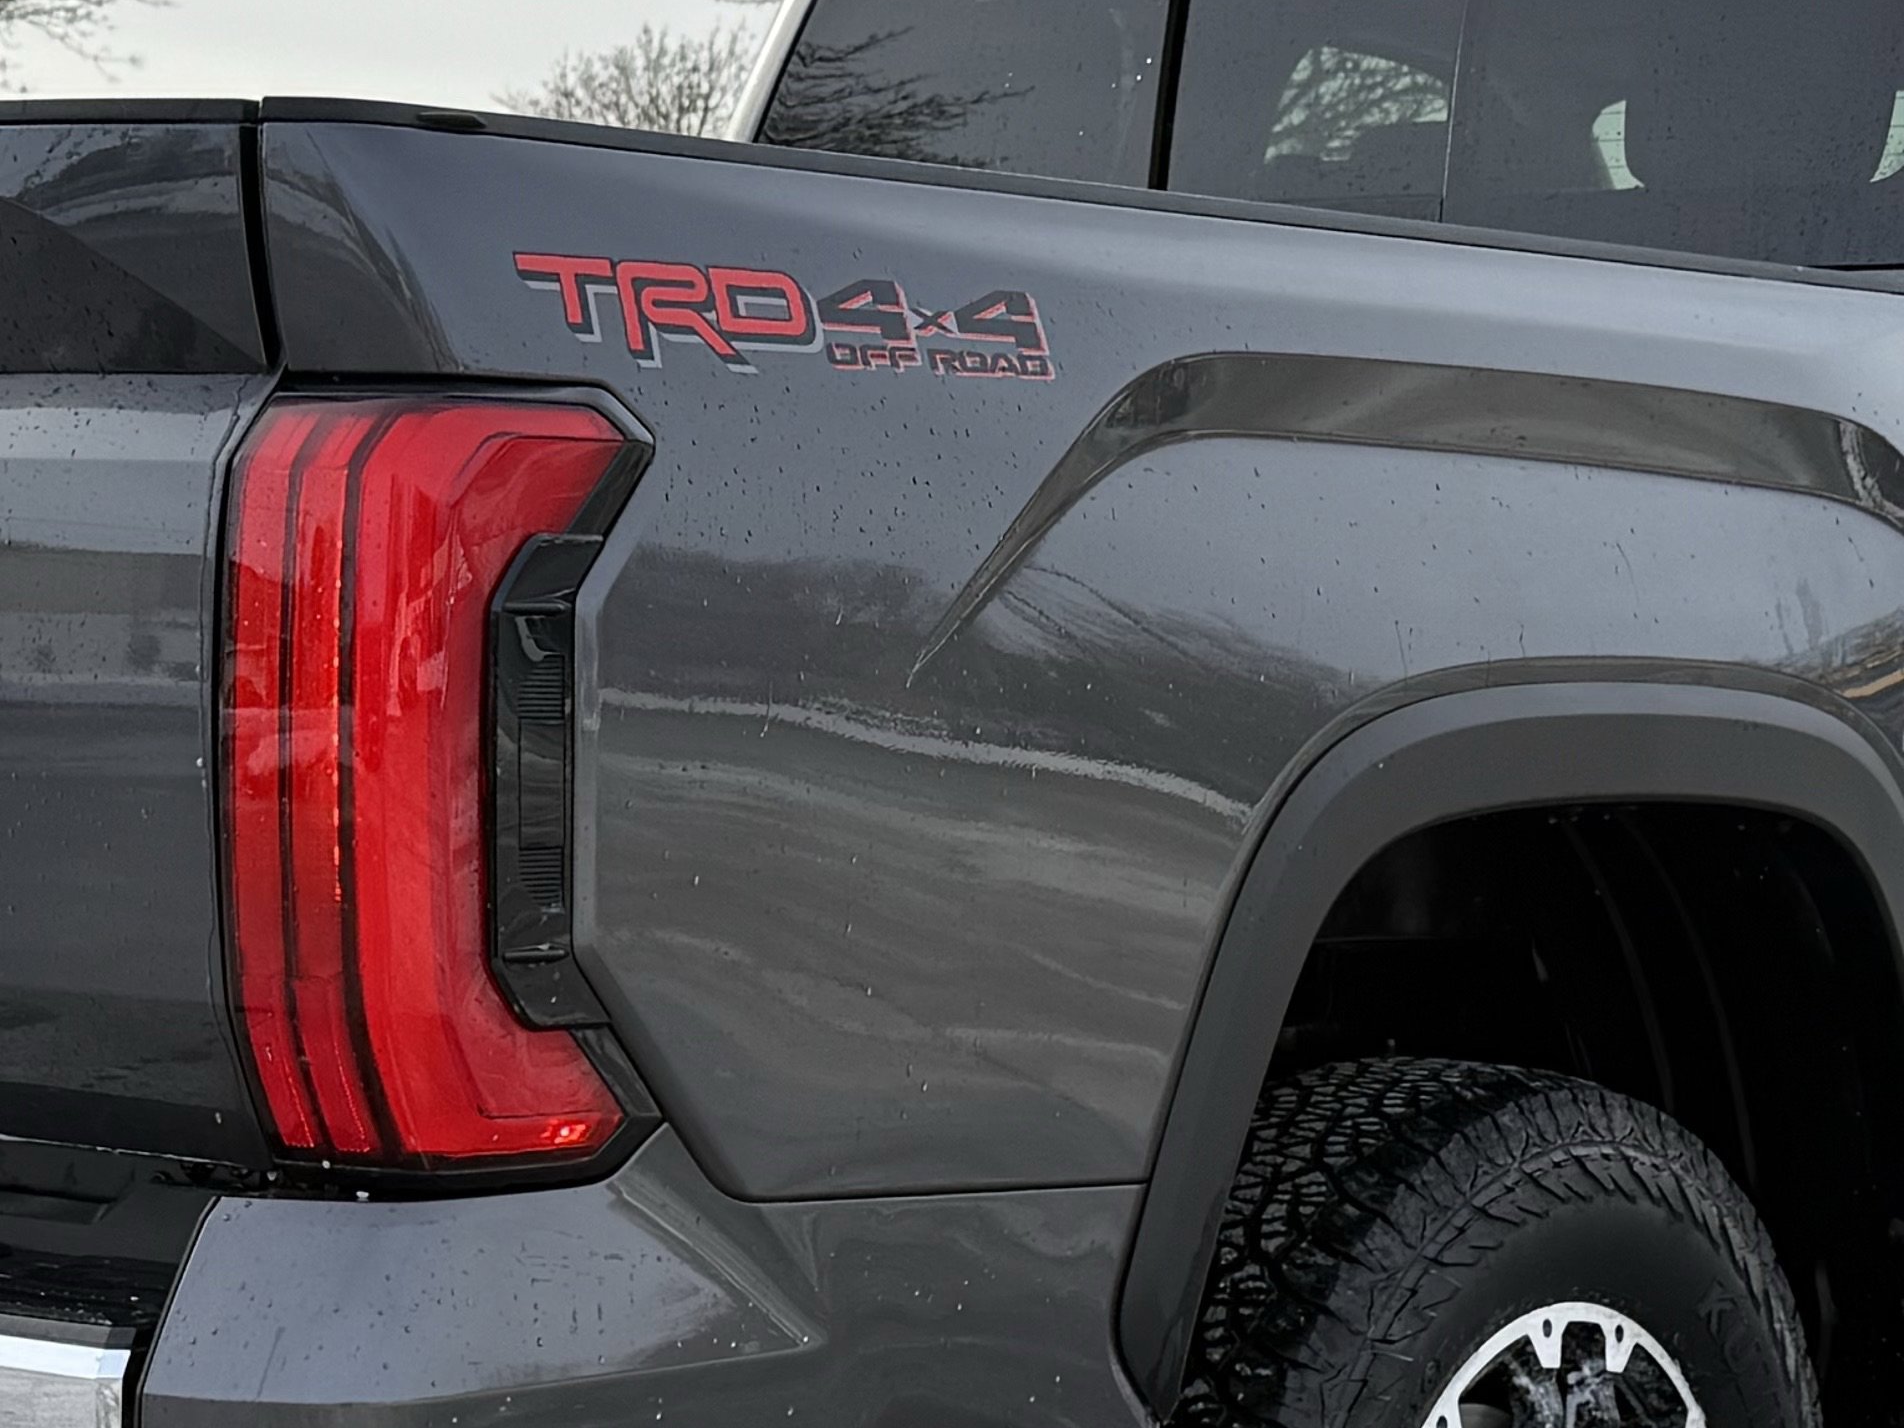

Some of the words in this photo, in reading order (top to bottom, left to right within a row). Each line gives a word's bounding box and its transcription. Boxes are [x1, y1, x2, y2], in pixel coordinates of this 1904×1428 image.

[512, 252, 823, 374] TRD
[825, 342, 920, 372] OFF
[930, 347, 1056, 380] ROAD
